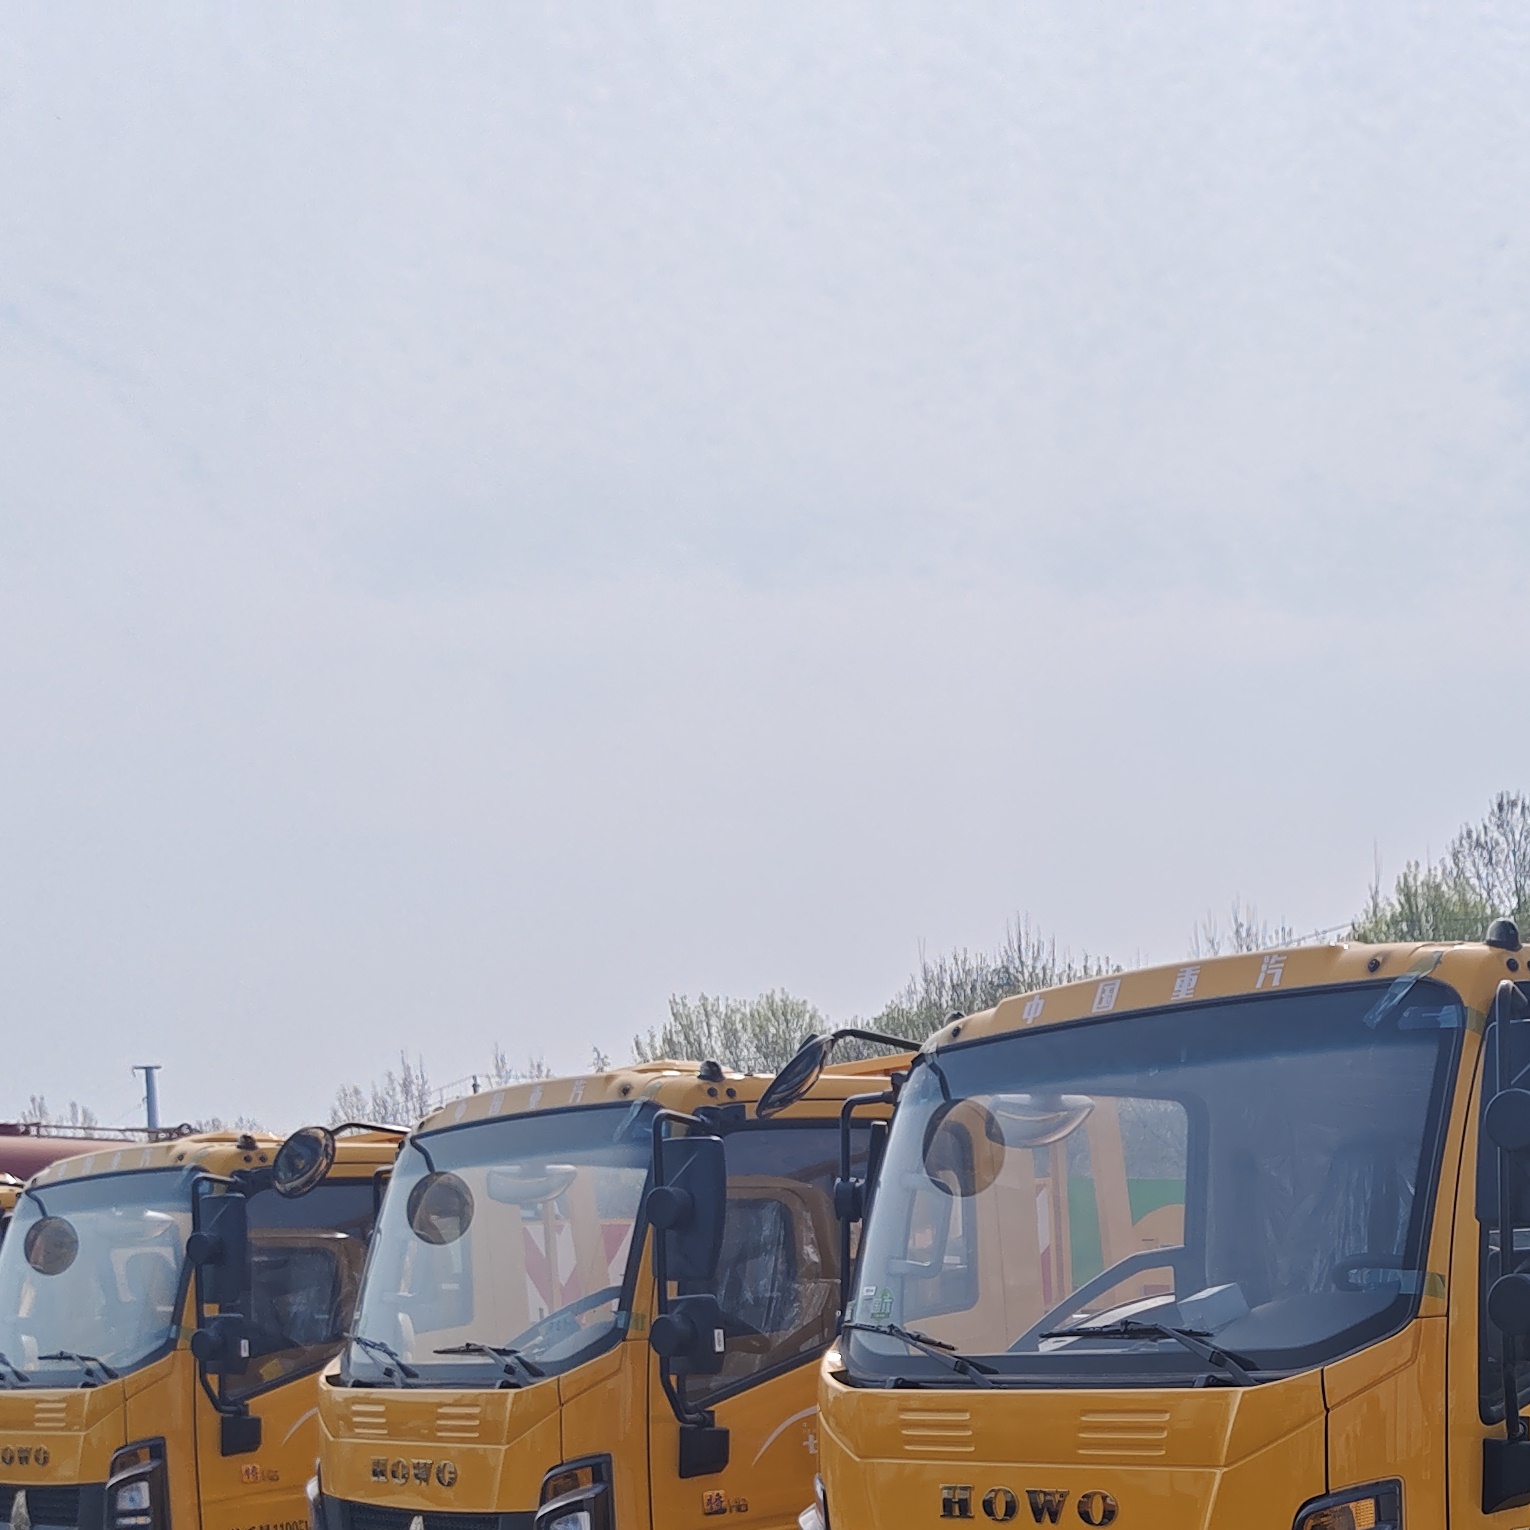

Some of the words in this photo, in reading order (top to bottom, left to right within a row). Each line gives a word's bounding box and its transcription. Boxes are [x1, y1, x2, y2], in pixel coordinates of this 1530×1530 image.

[1022, 953, 1288, 1025] 中国重汽
[370, 1456, 459, 1488] HOWO
[939, 1483, 1119, 1527] HOWO
